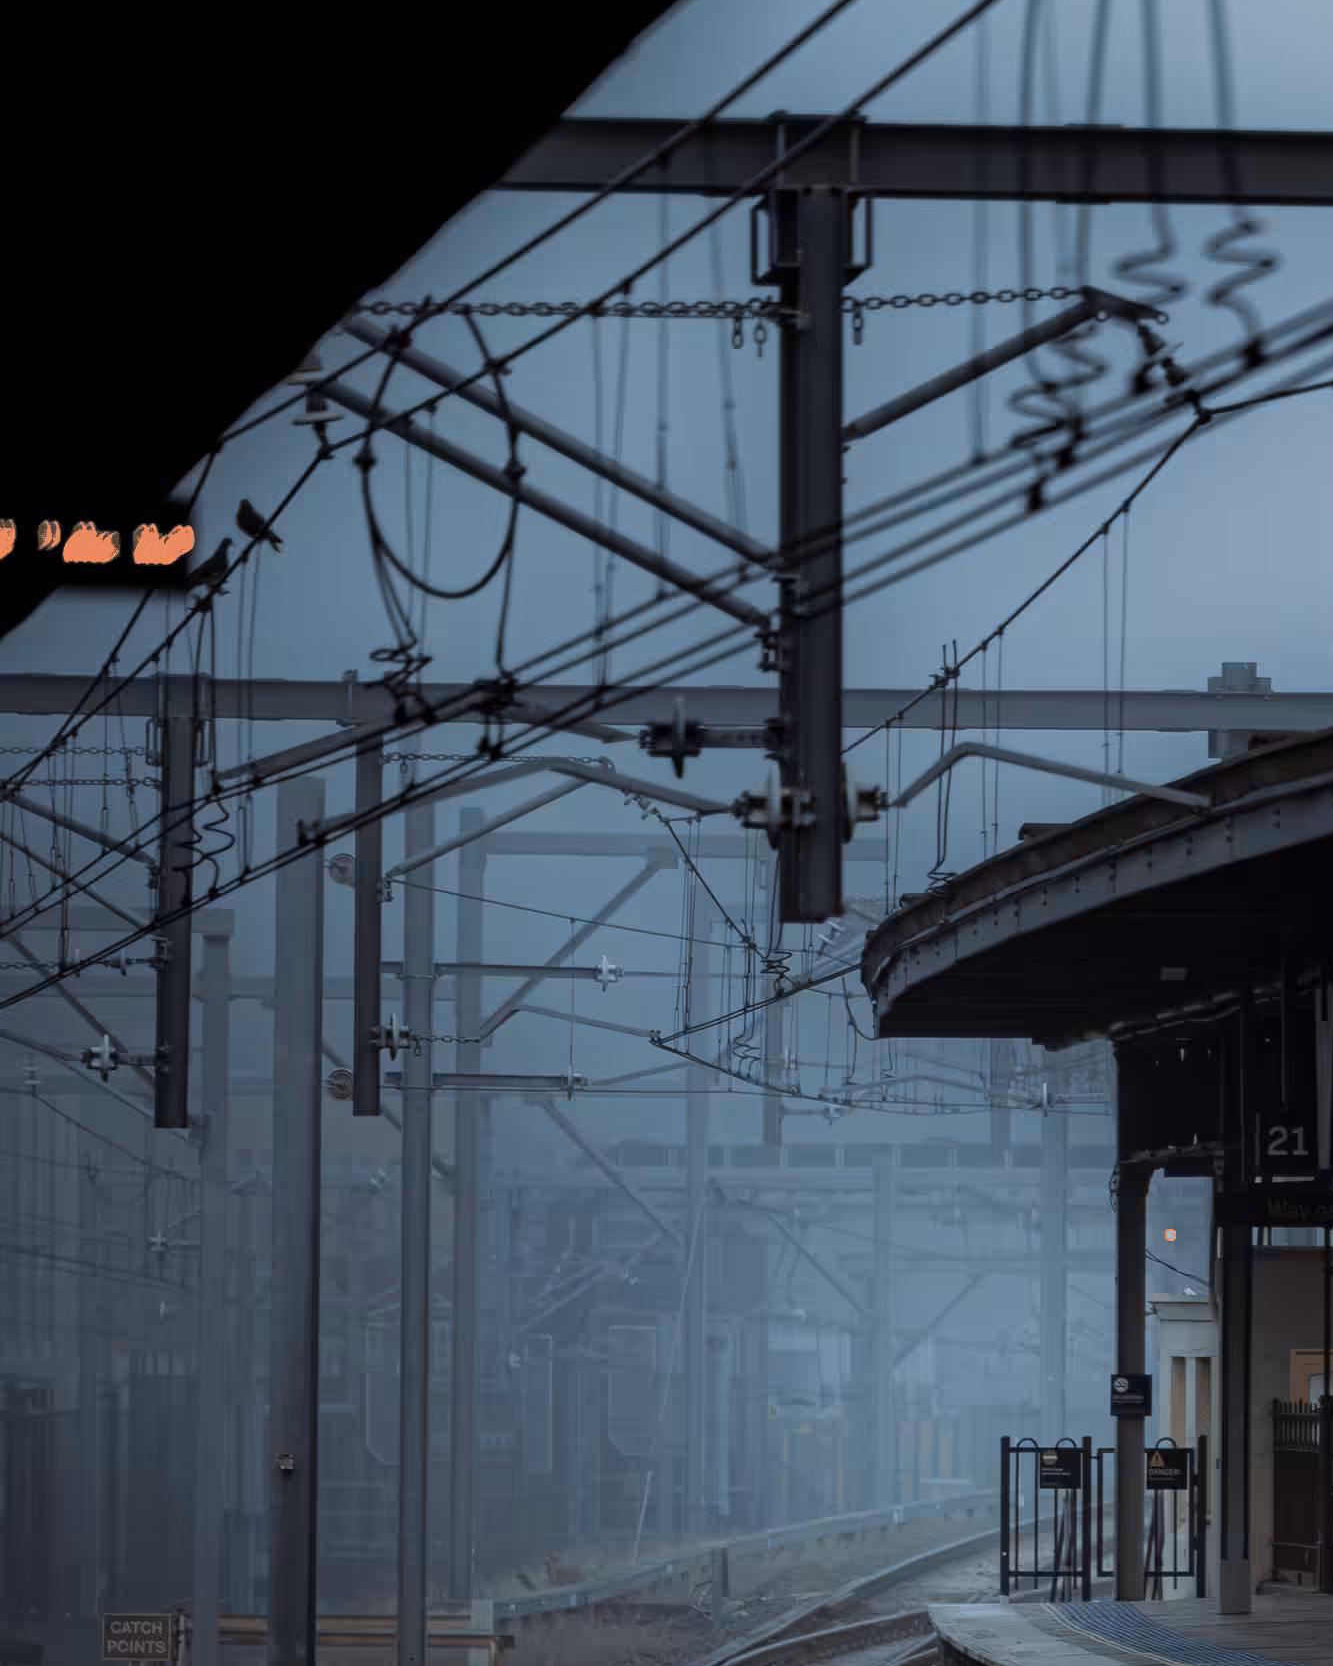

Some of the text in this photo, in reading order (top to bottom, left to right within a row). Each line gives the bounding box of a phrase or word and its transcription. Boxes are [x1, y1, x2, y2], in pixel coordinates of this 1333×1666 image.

[1266, 1125, 1310, 1157] 21
[109, 1620, 164, 1635] CATCH
[107, 1638, 167, 1654] POINTS
